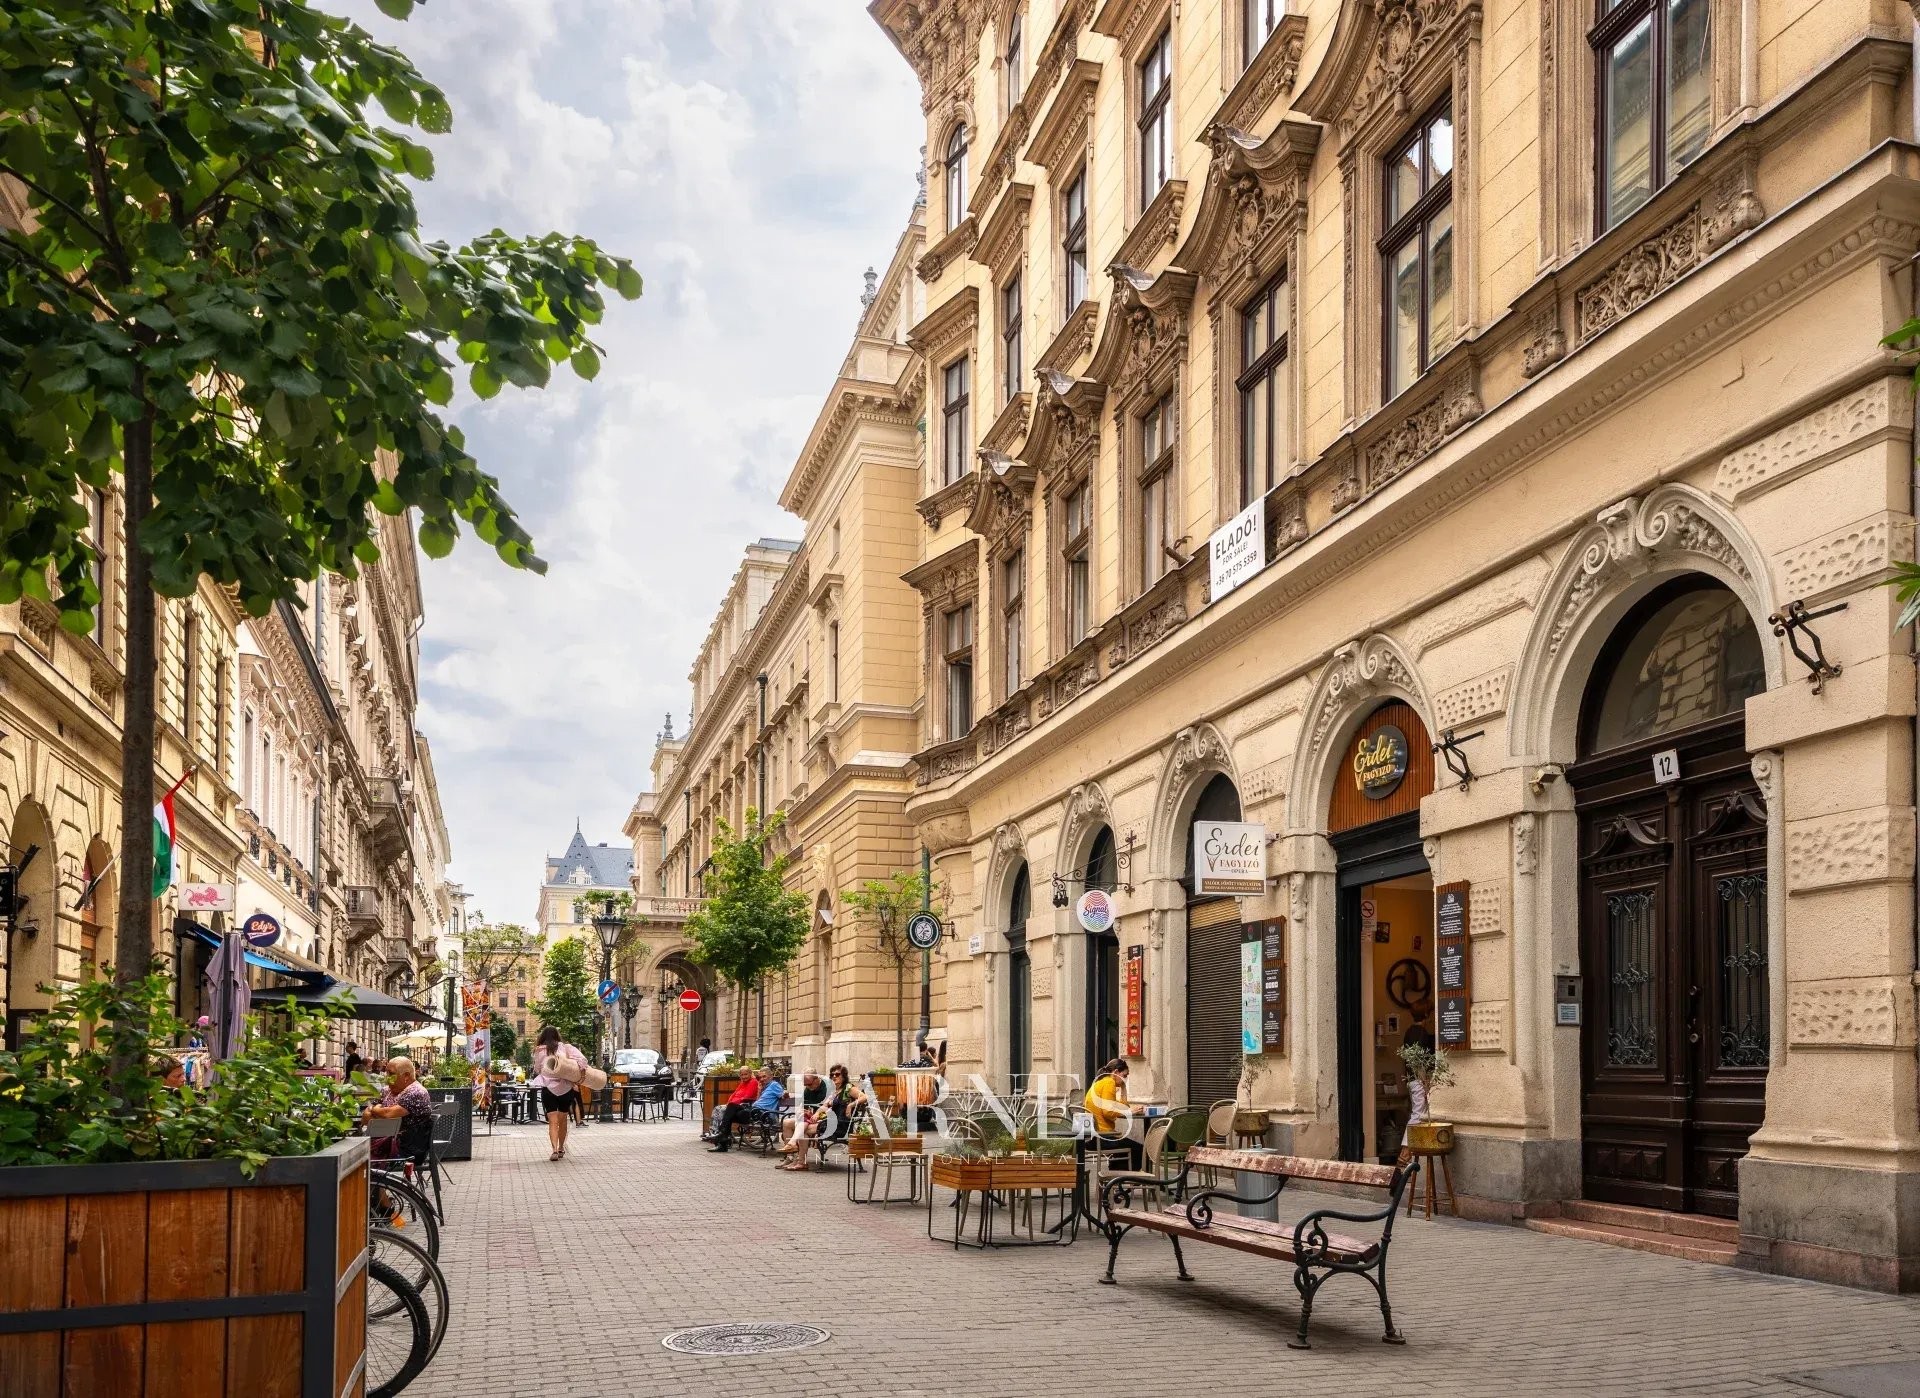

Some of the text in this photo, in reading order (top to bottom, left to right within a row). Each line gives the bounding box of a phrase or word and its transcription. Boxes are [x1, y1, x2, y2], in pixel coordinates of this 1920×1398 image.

[1215, 514, 1257, 560] ELADÓ!
[1222, 541, 1249, 566] FOR SALE!
[1354, 734, 1394, 773] Erdei
[1659, 756, 1673, 777] 12
[1204, 827, 1262, 858] Erdei
[1219, 858, 1260, 868] FAGYIZÓ
